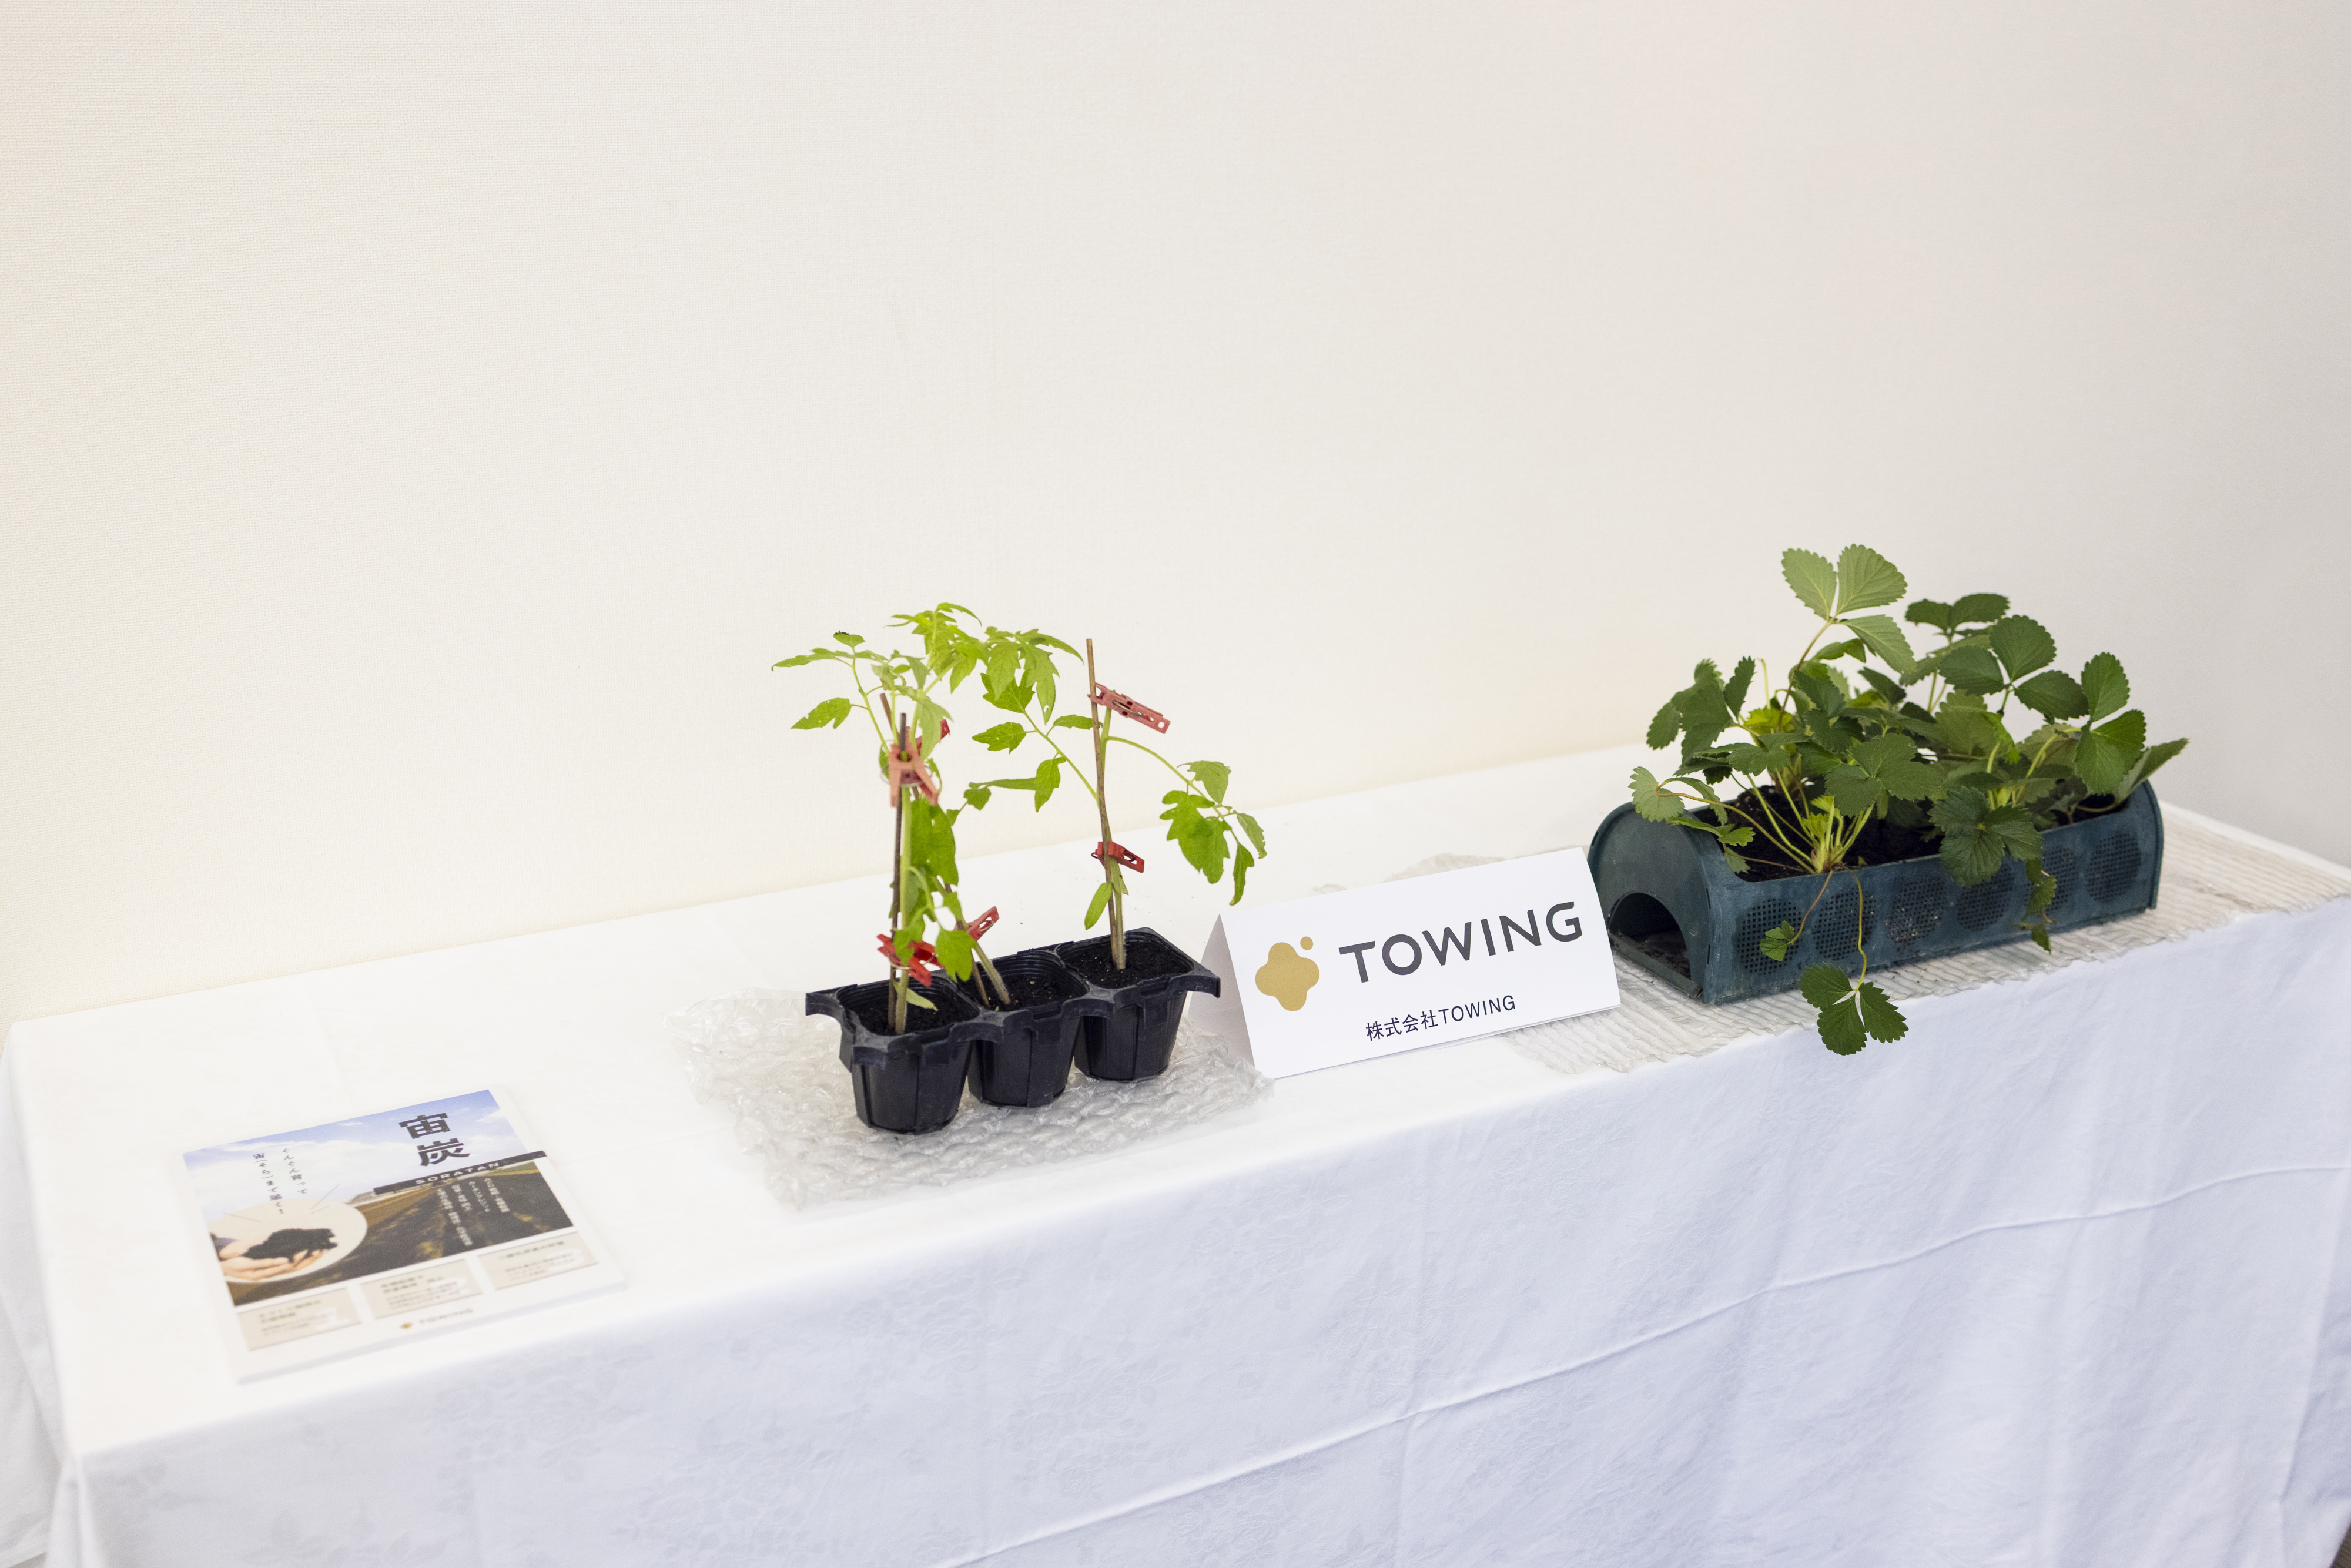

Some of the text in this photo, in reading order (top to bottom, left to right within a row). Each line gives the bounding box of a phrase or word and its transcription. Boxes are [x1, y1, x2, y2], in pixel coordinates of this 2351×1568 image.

[1338, 901, 1583, 983] TOWING
[1365, 995, 1516, 1041] 株式会社TOWING
[398, 1113, 470, 1167] 宙炭
[416, 1162, 500, 1185] SORATAN
